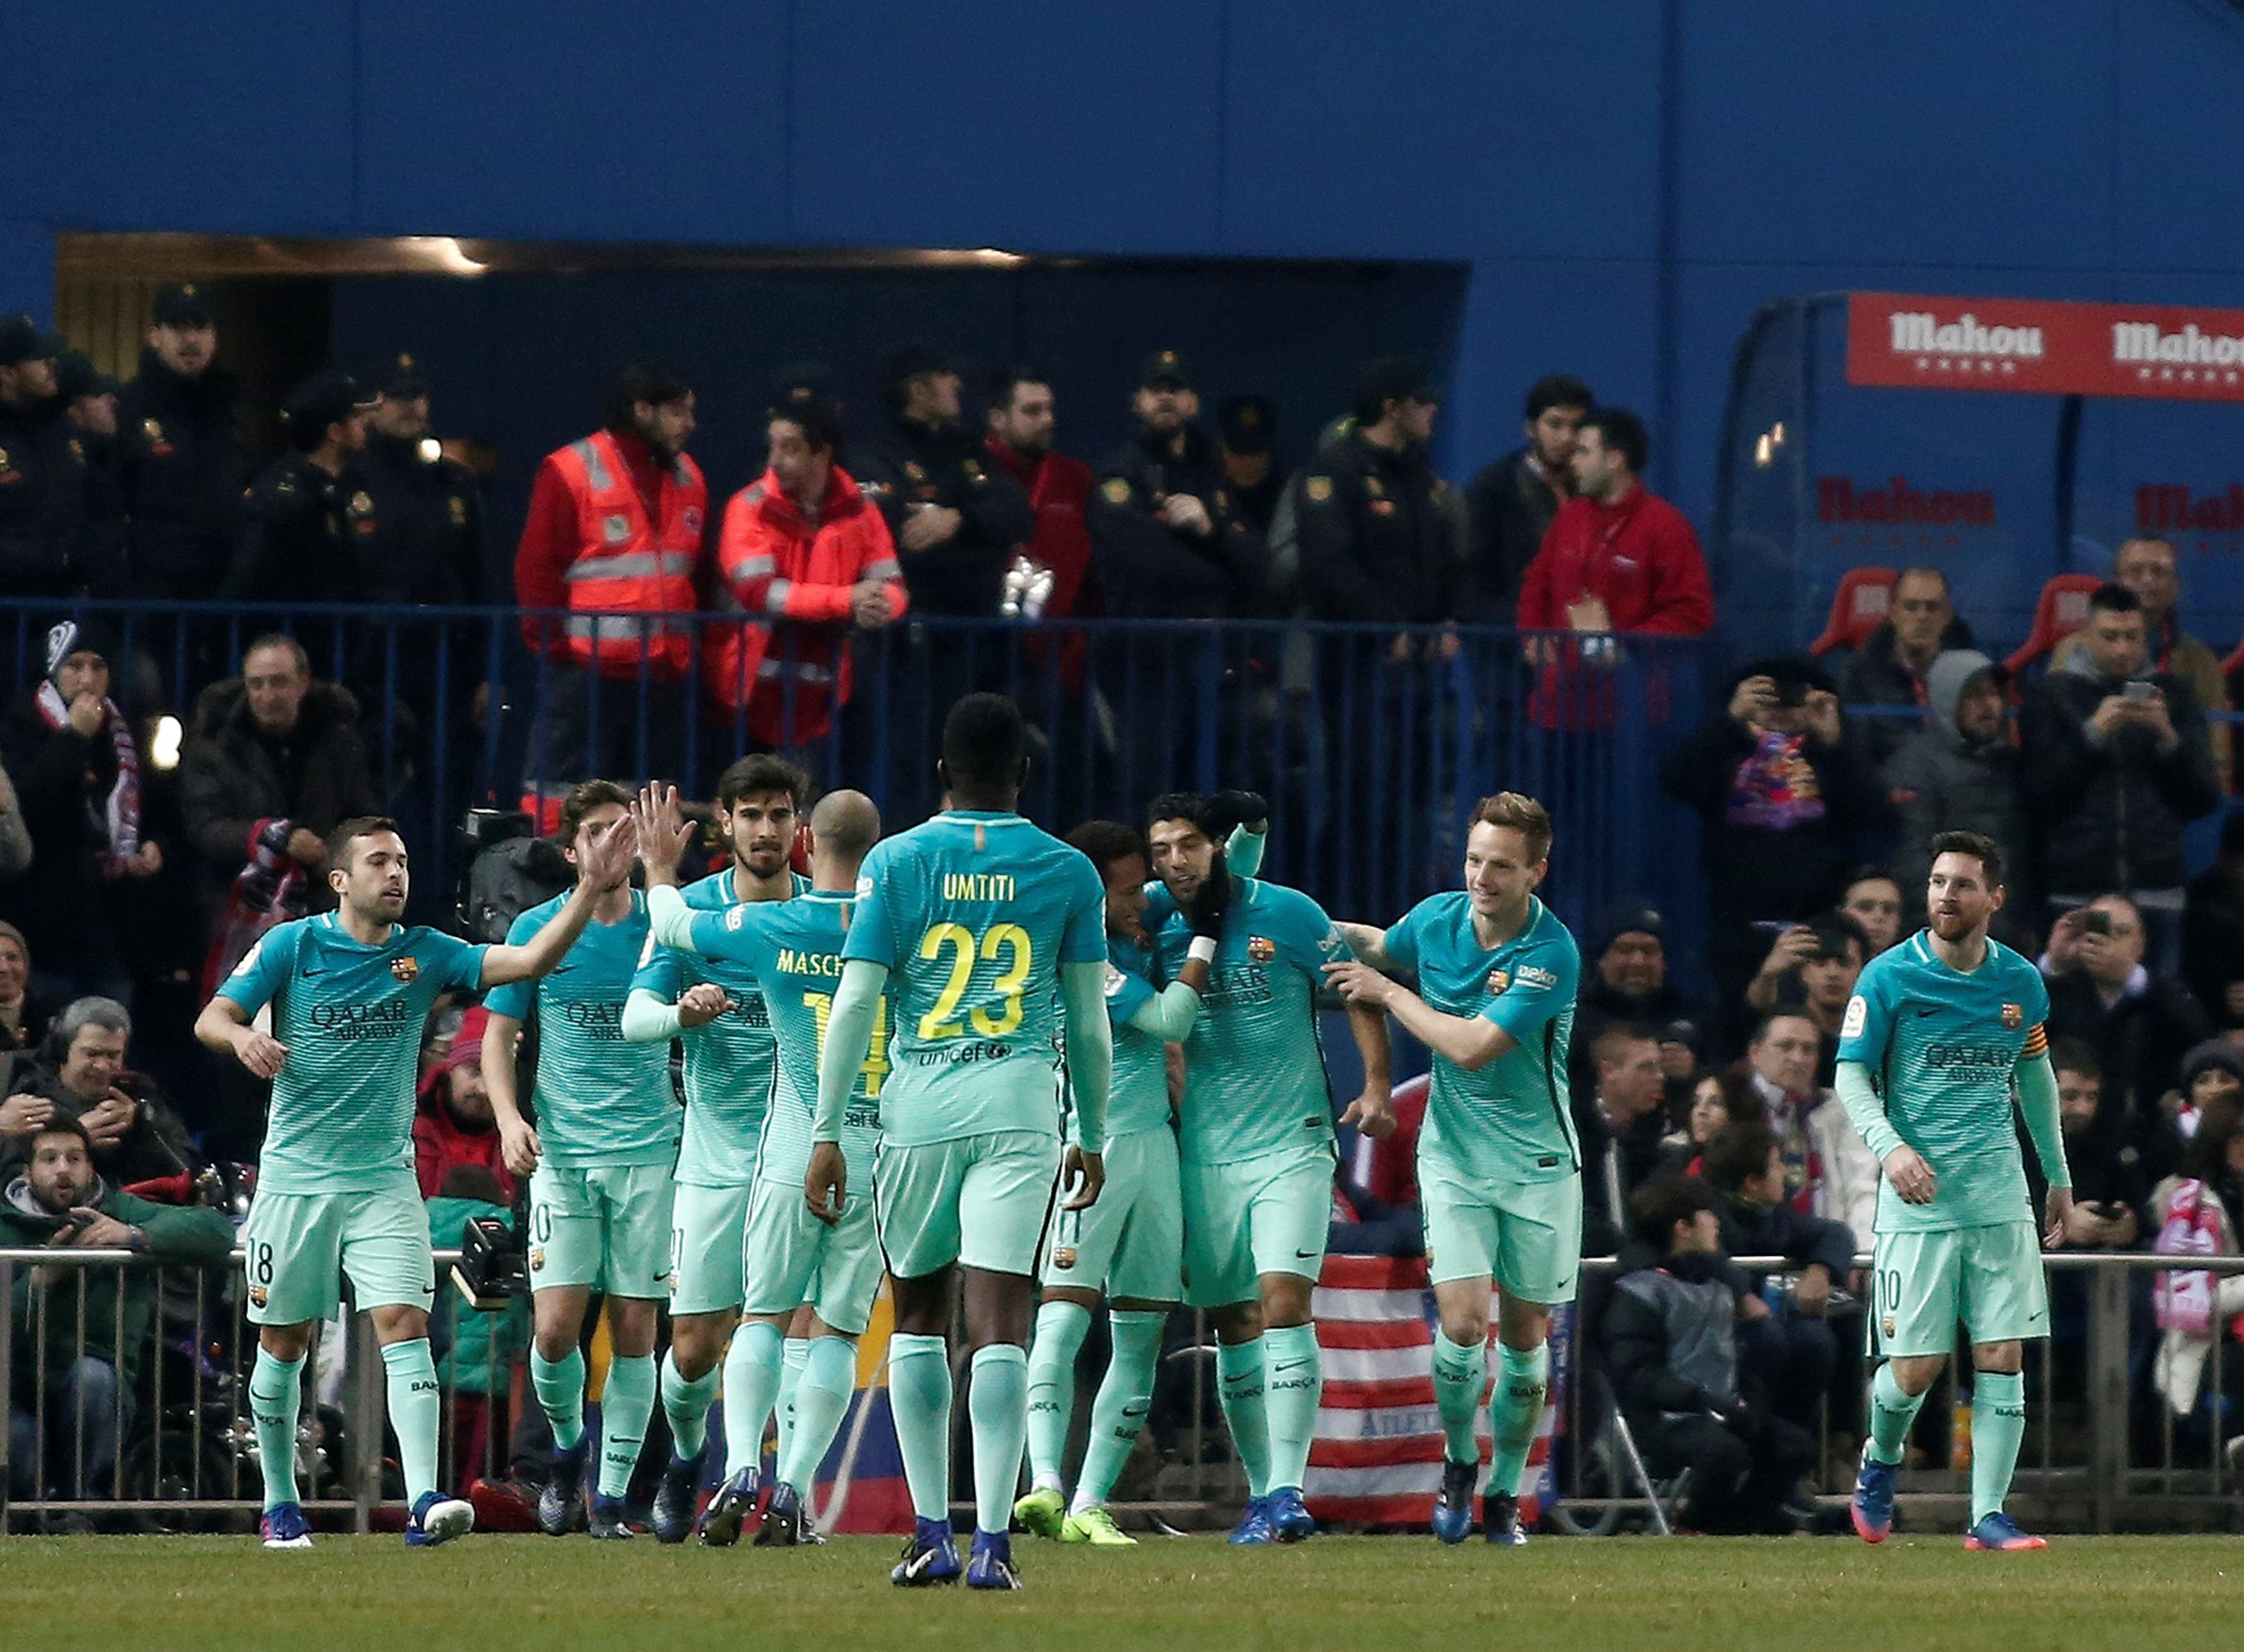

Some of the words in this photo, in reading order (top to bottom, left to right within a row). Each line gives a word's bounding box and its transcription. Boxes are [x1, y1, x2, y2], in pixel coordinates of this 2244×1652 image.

[1890, 311, 2043, 358] Mahou
[2112, 322, 2244, 364] Maho
[944, 872, 1014, 902] UMTITI
[917, 922, 1032, 1040] 23
[311, 999, 407, 1030] QATAR
[919, 1040, 985, 1066] unicef
[1927, 1045, 2013, 1069] QATAR
[249, 1237, 273, 1285] 18
[1877, 1269, 1901, 1311] 10
